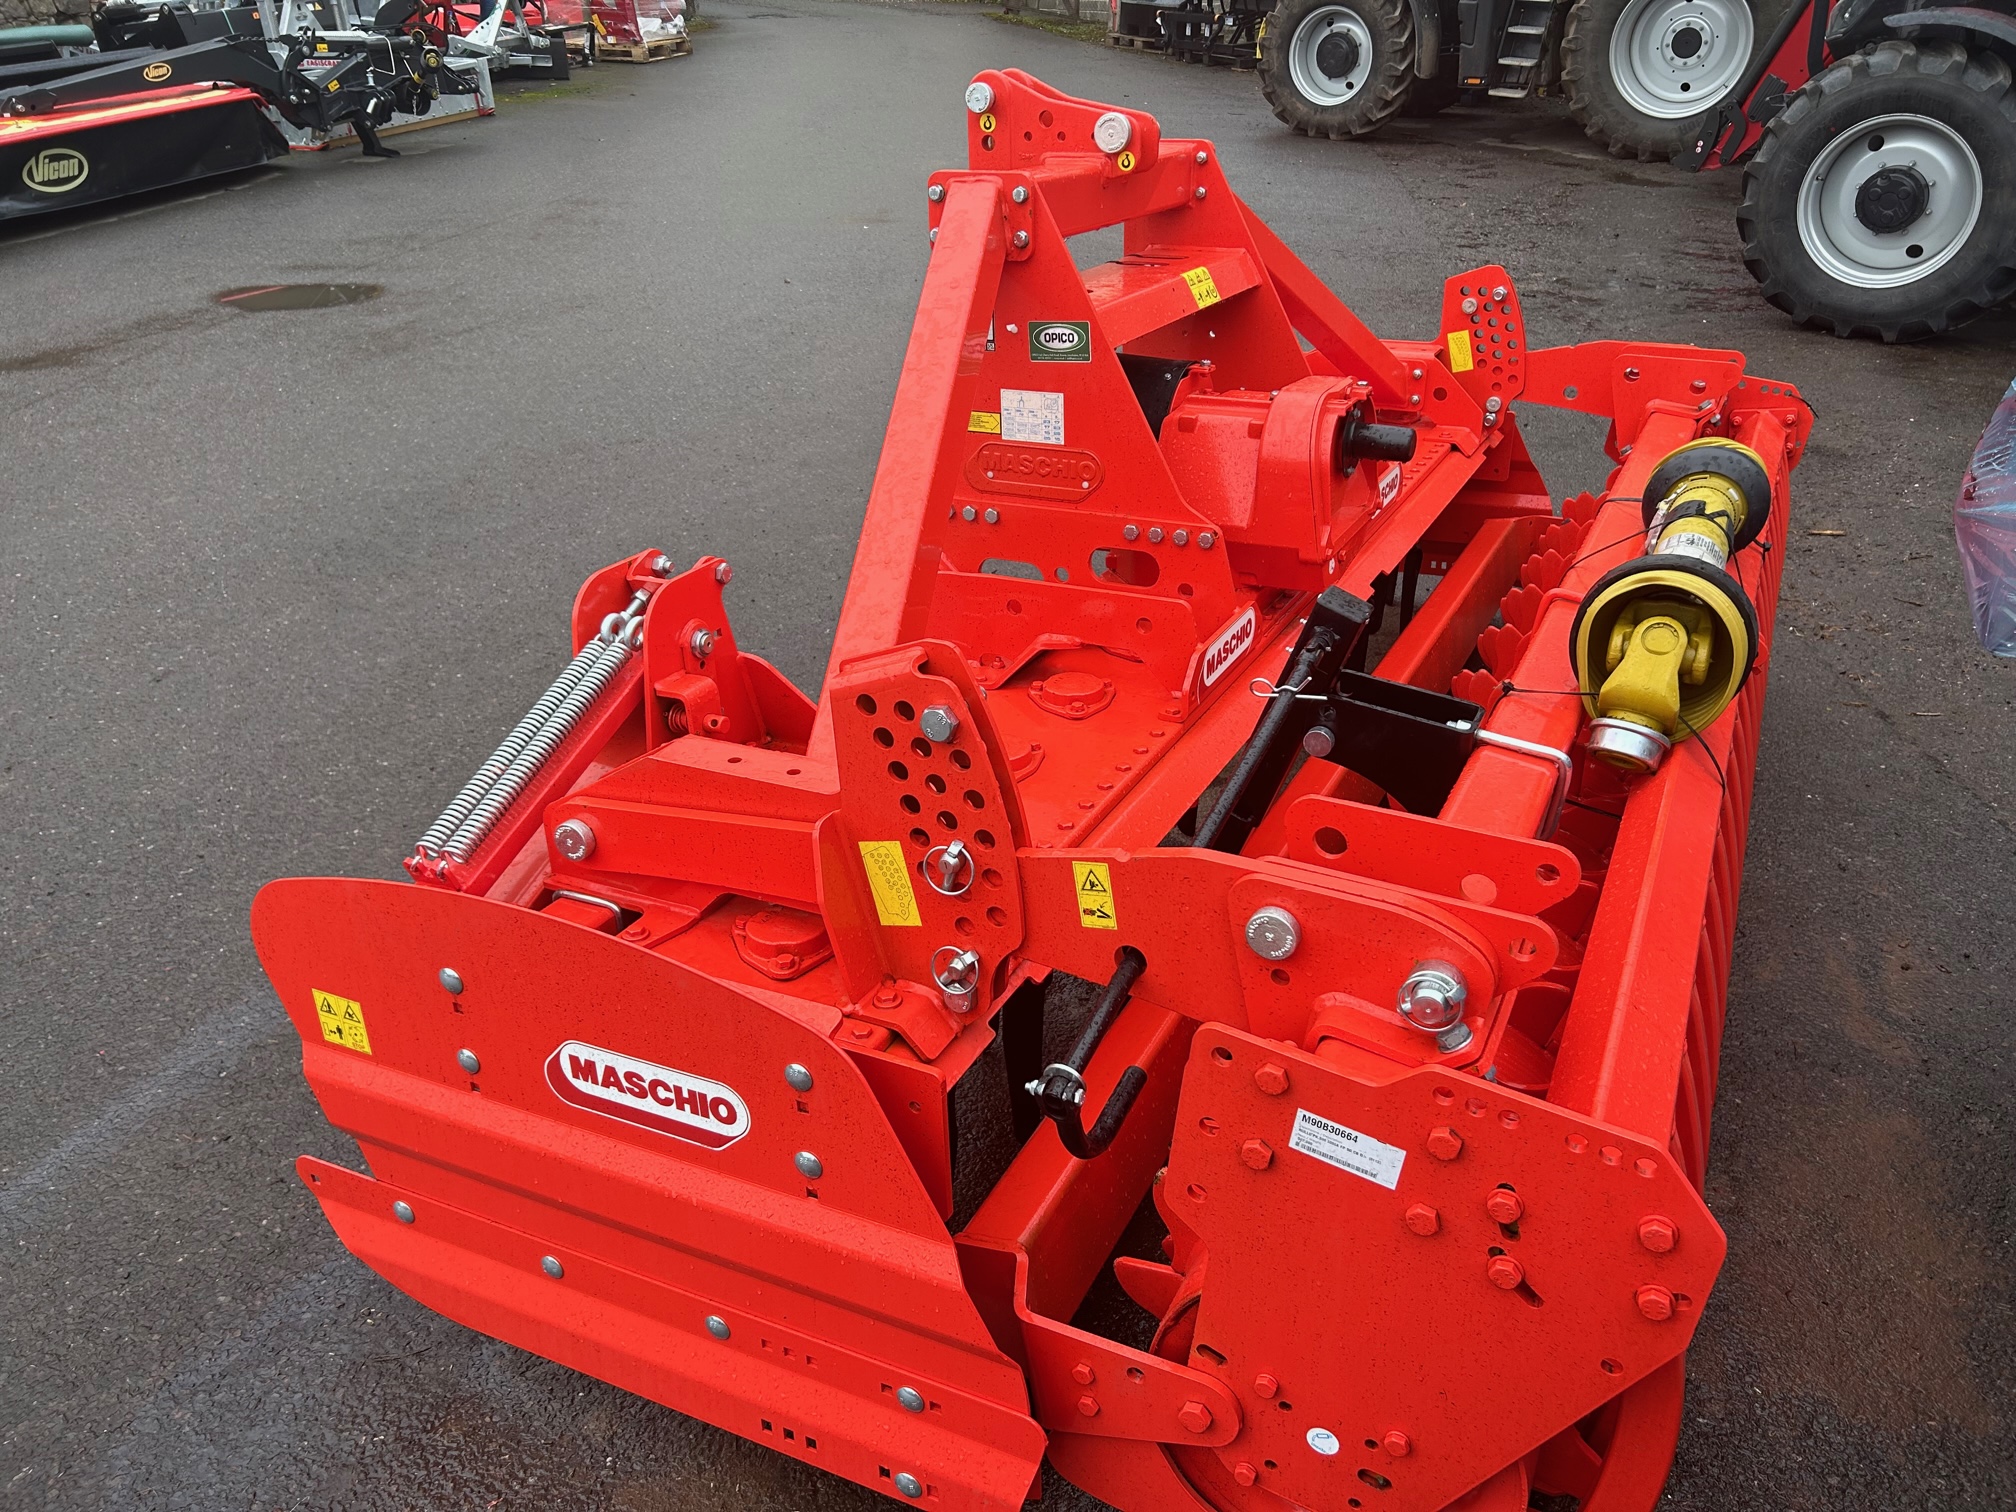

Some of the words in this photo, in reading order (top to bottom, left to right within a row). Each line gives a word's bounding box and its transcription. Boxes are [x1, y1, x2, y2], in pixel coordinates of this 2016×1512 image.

[147, 65, 168, 78] Vicon
[31, 153, 79, 183] Vicon
[1044, 332, 1075, 343] OPICO
[982, 451, 1097, 480] MASCHIO
[1206, 617, 1252, 680] MASCHIO
[568, 1053, 738, 1126] MASCHIO
[1301, 1113, 1359, 1144] M90B30664
